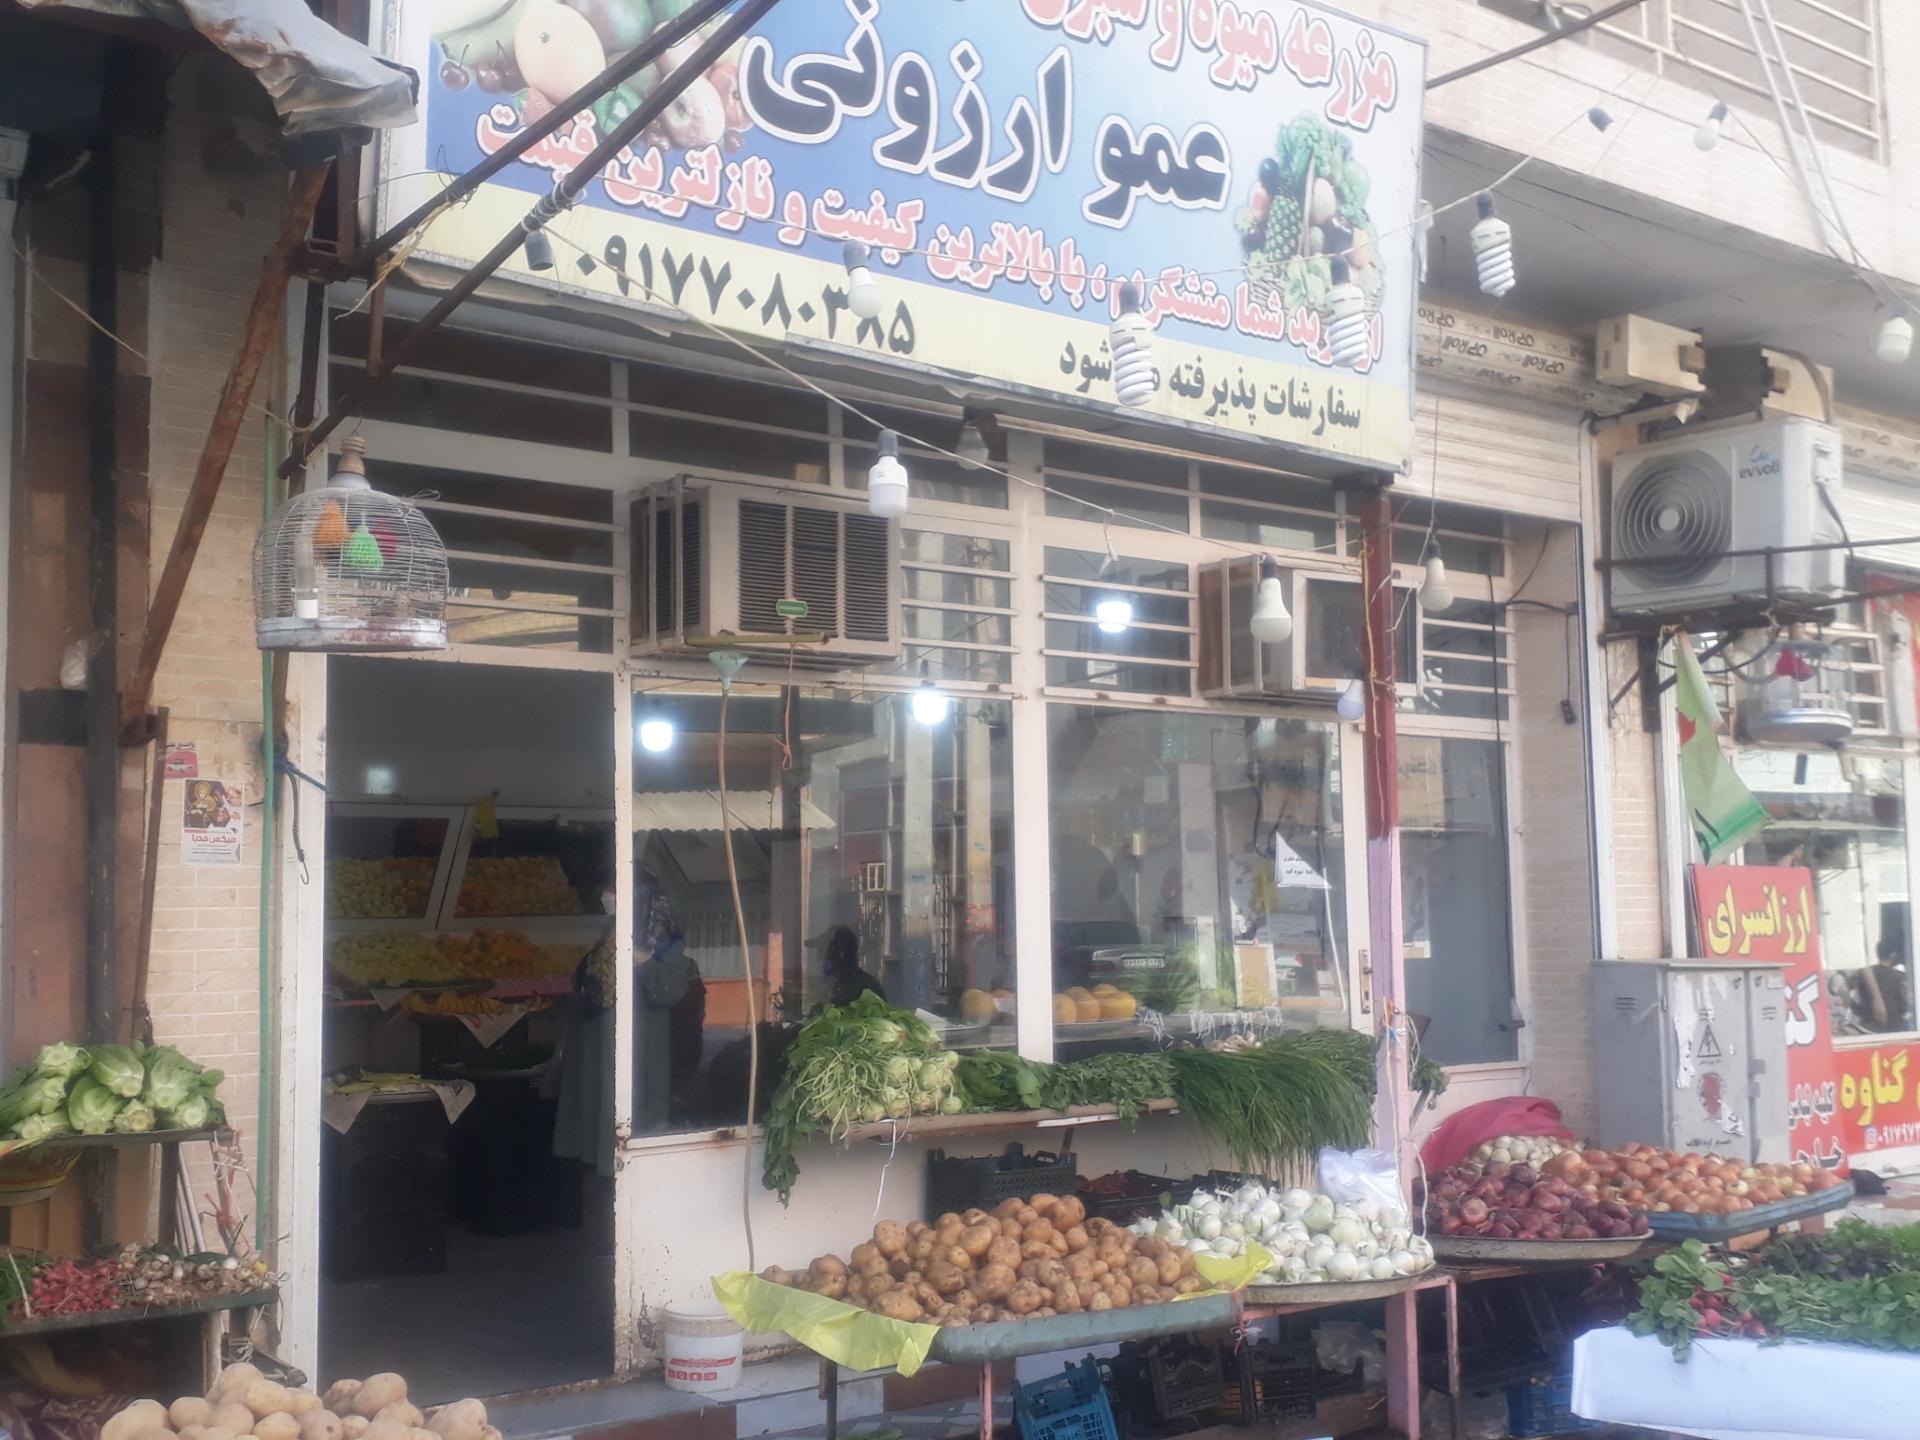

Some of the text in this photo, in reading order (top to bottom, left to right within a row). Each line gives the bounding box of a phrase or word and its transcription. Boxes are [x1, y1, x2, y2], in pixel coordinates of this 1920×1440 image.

[1188, 0, 1279, 90] میوه
[1282, 8, 1398, 132] مزرعه
[738, 0, 1231, 228] عمو ارزونی
[777, 190, 808, 246] و
[926, 222, 1055, 304] بالاترین
[1059, 237, 1086, 310] با
[1234, 279, 1284, 341] شما
[1059, 339, 1113, 393] شود
[1168, 355, 1257, 425] پذیرفته
[1263, 377, 1361, 436] سفارشات
[1840, 1048, 1910, 1127] گناوه
